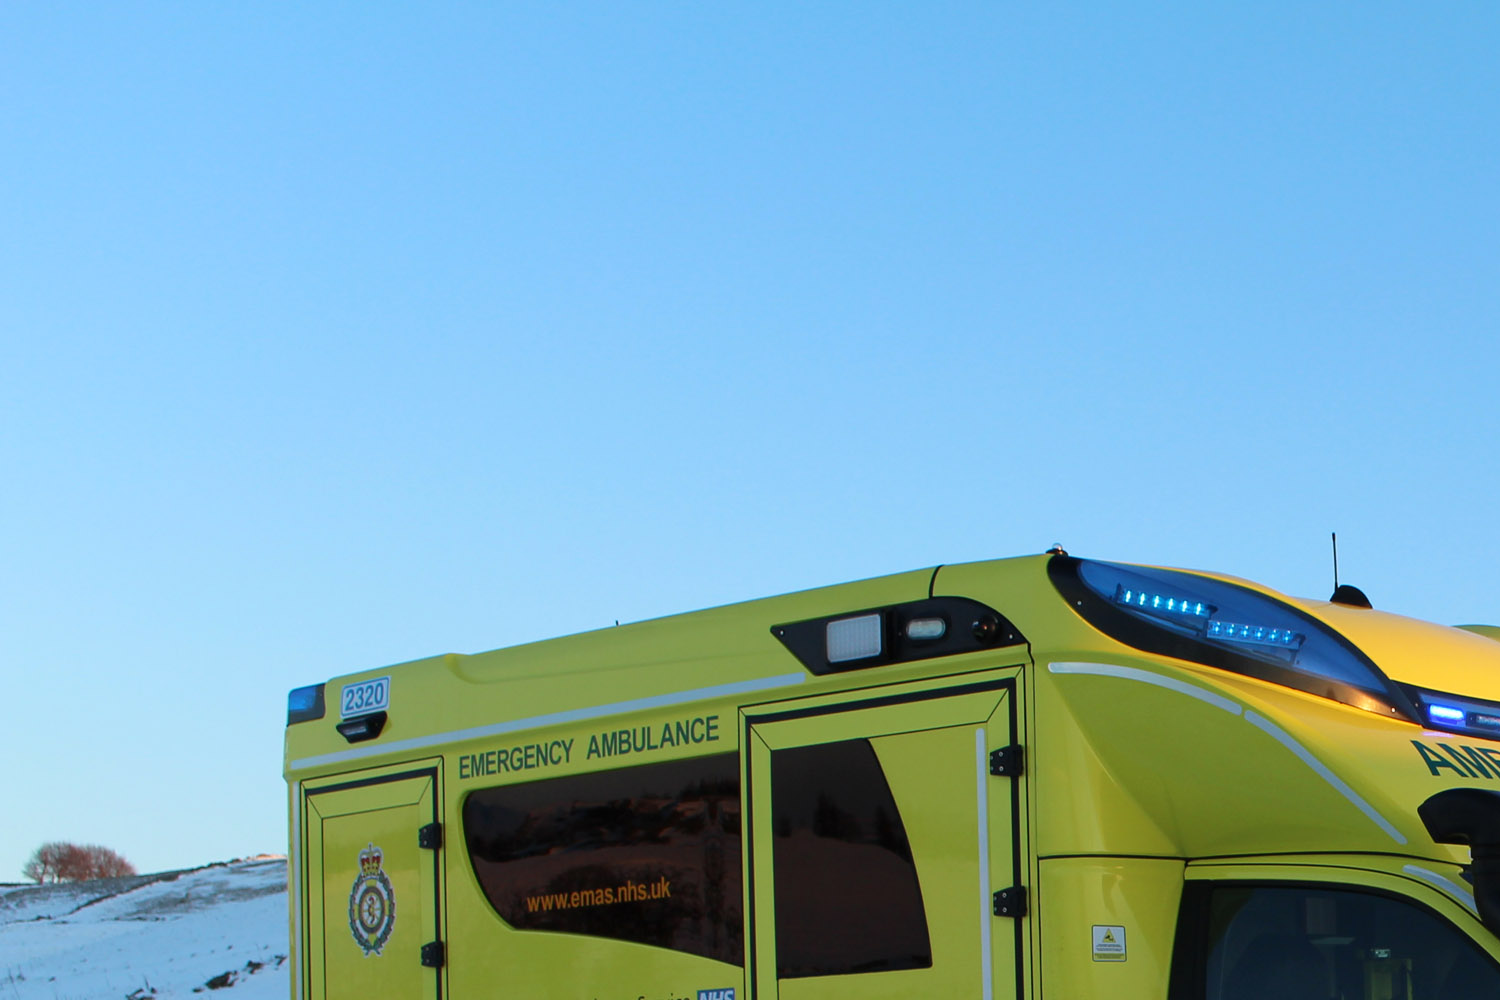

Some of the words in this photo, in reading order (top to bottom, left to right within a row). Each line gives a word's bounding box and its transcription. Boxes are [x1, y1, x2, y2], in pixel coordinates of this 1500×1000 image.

[345, 681, 384, 711] 2320
[459, 738, 574, 779] EMERGENCY
[586, 715, 719, 759] AMBULANCE
[526, 876, 671, 913] www.emas.nhs.uk
